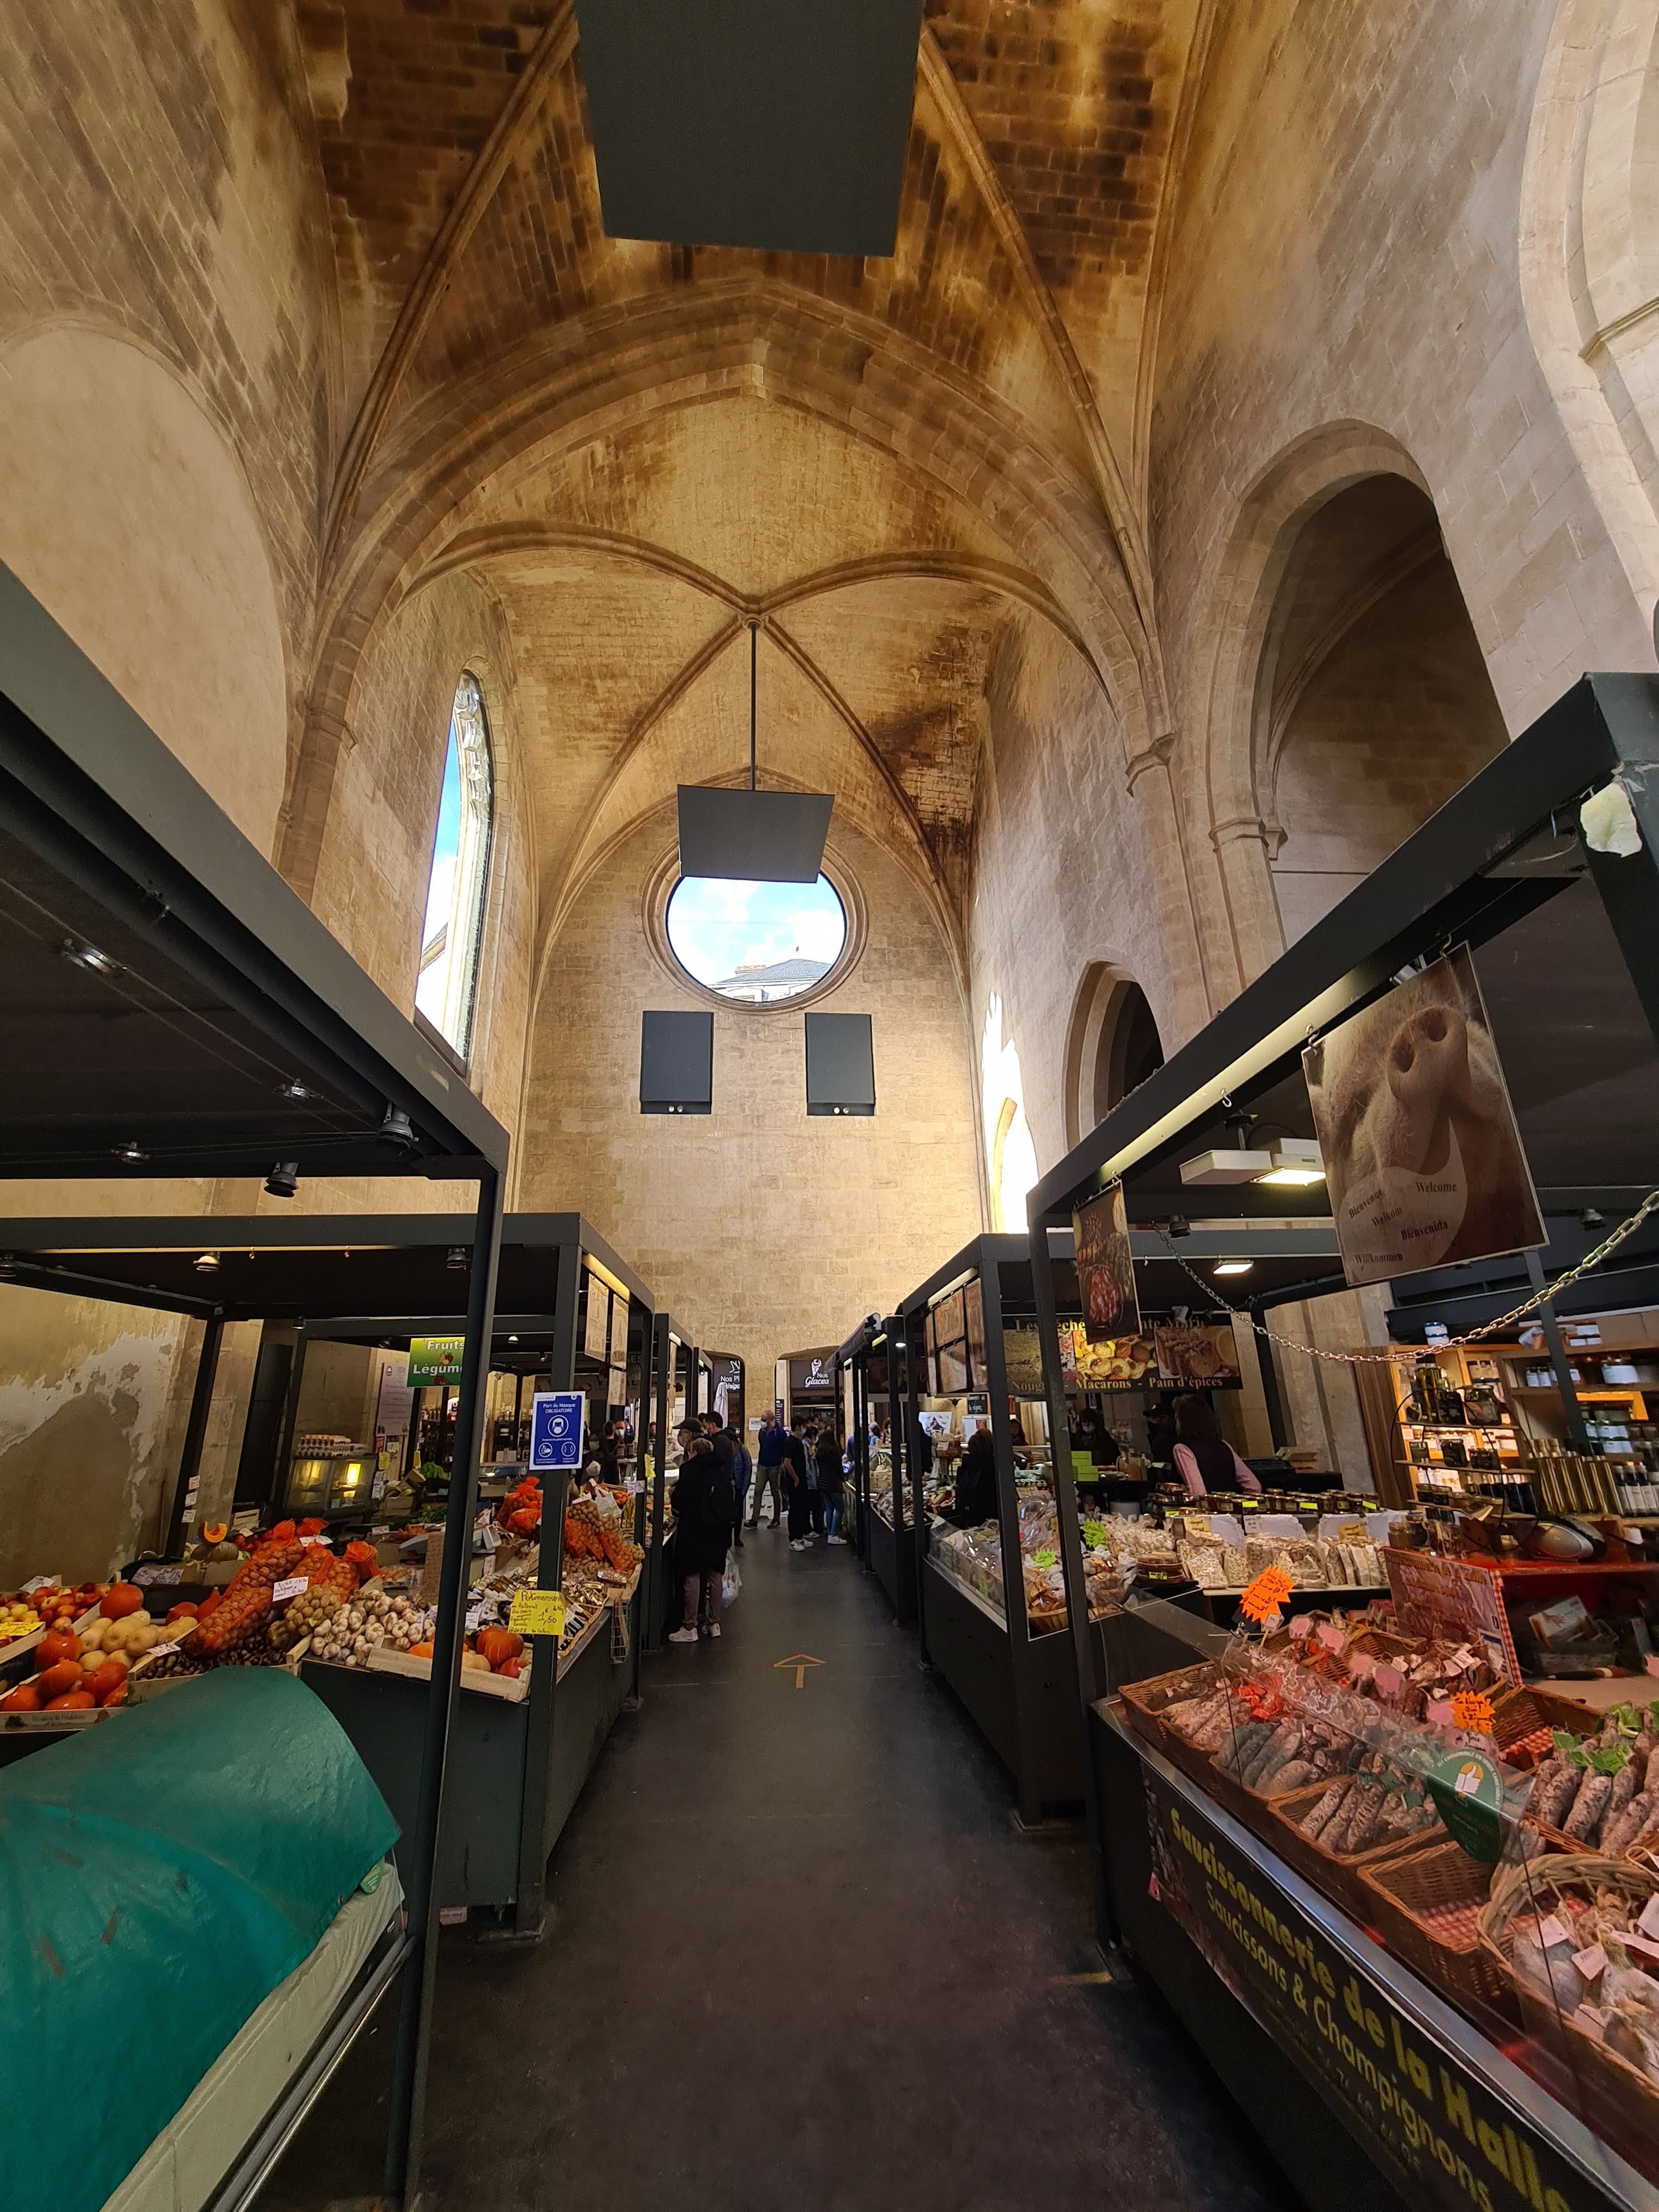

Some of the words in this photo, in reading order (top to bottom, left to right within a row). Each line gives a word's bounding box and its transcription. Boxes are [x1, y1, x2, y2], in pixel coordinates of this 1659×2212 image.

[1416, 1182, 1457, 1193] Welcome
[1348, 1188, 1383, 1218] Bienvenue
[1371, 1206, 1403, 1227] Welkom
[1401, 1219, 1448, 1240] Bienvenida
[1354, 1251, 1403, 1264] Willkommen
[413, 1363, 462, 1376] Légum
[805, 1376, 830, 1388] Glaces
[1076, 1379, 1131, 1390] Macarons
[1149, 1378, 1174, 1388] Pain
[1177, 1376, 1223, 1390] d'épices
[1171, 1807, 1336, 1999] Saucissonnerie
[1343, 1975, 1385, 2048] de
[1390, 2013, 1433, 2101] la
[1206, 1881, 1288, 1992] Saucissons
[1292, 1972, 1308, 2017] &
[1314, 1996, 1493, 2212] Champignons
